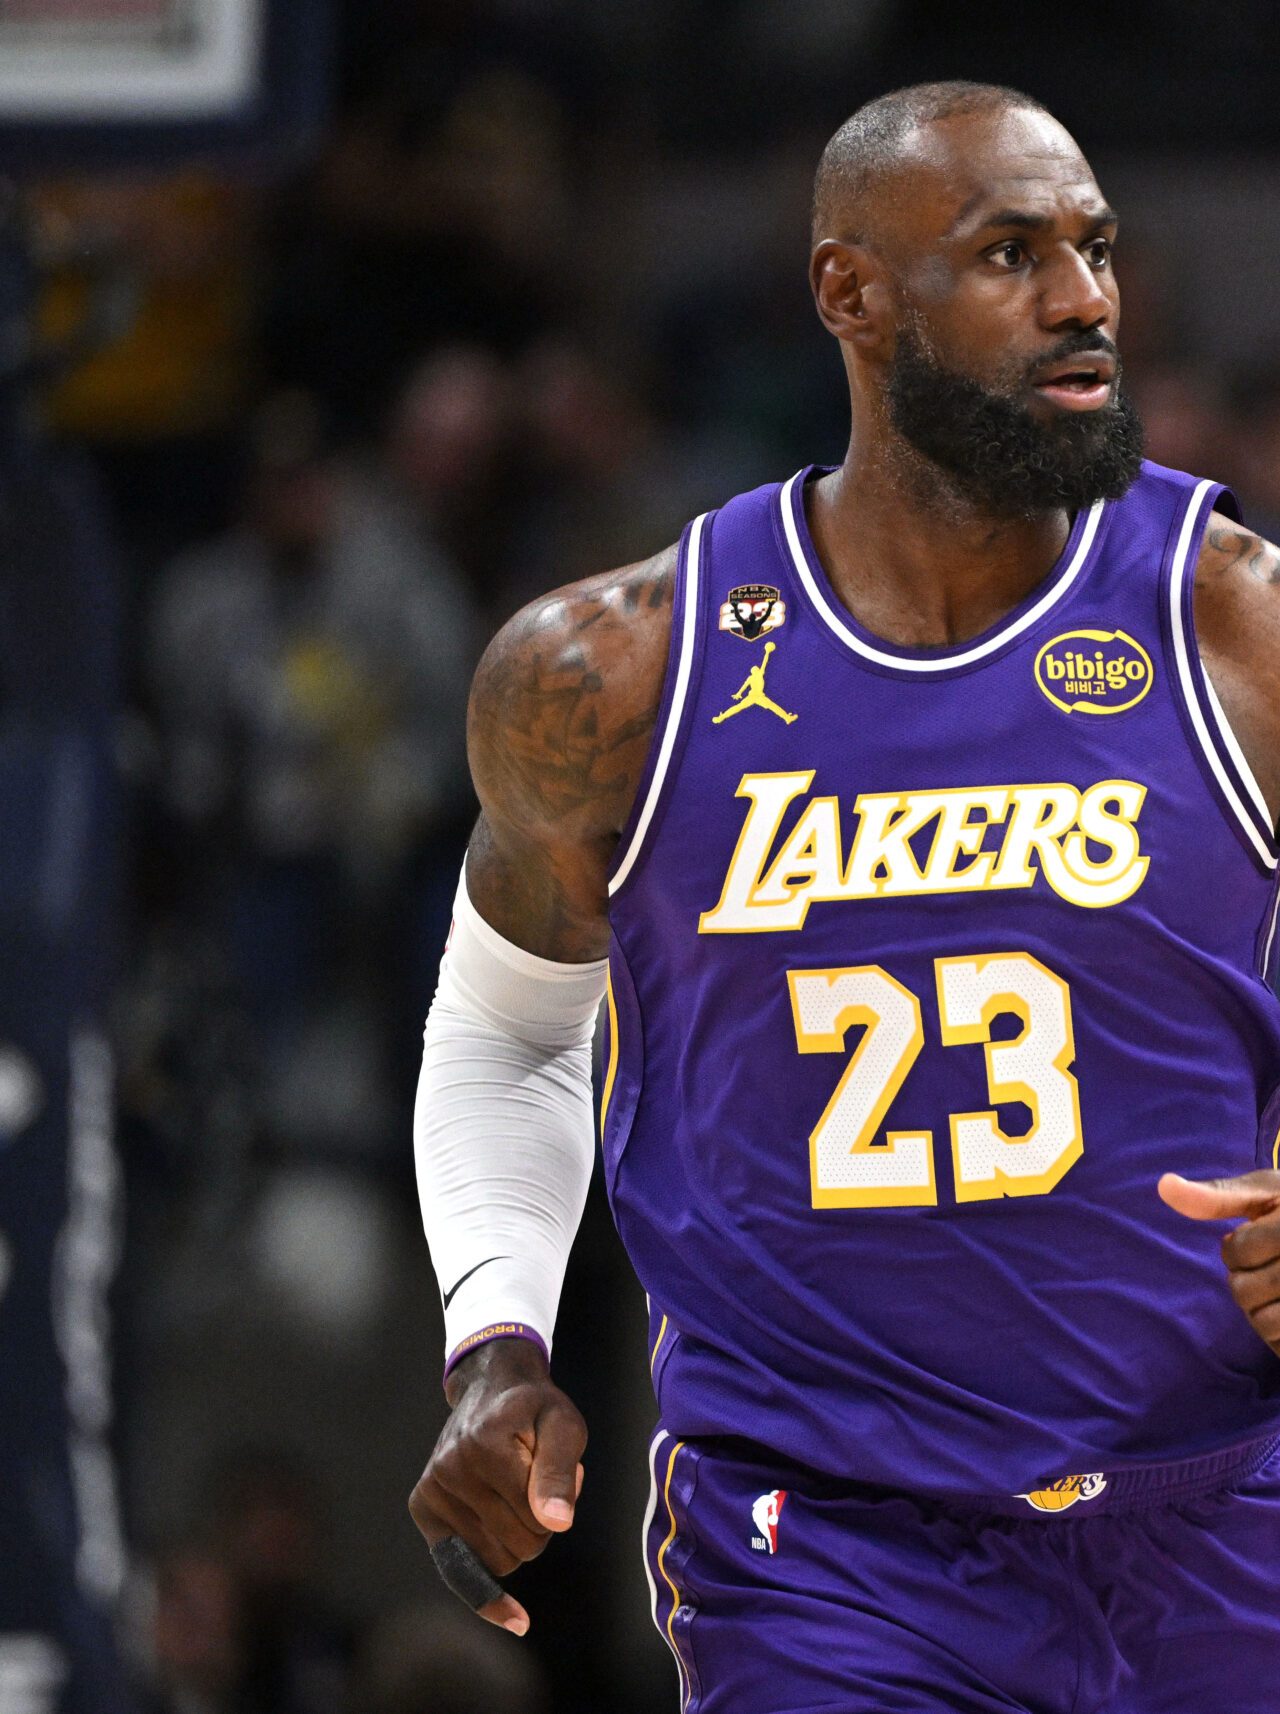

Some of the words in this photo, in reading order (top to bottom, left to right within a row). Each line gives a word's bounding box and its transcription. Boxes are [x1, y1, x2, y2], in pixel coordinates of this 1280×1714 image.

[737, 585, 770, 593] NBA
[719, 600, 786, 630] 23
[1045, 651, 1146, 690] bibigo
[1065, 681, 1107, 695] 비비고
[697, 769, 1151, 934] LAKERS
[786, 951, 1084, 1210] 23
[1046, 1473, 1101, 1497] ERS
[751, 1536, 767, 1551] NBA
